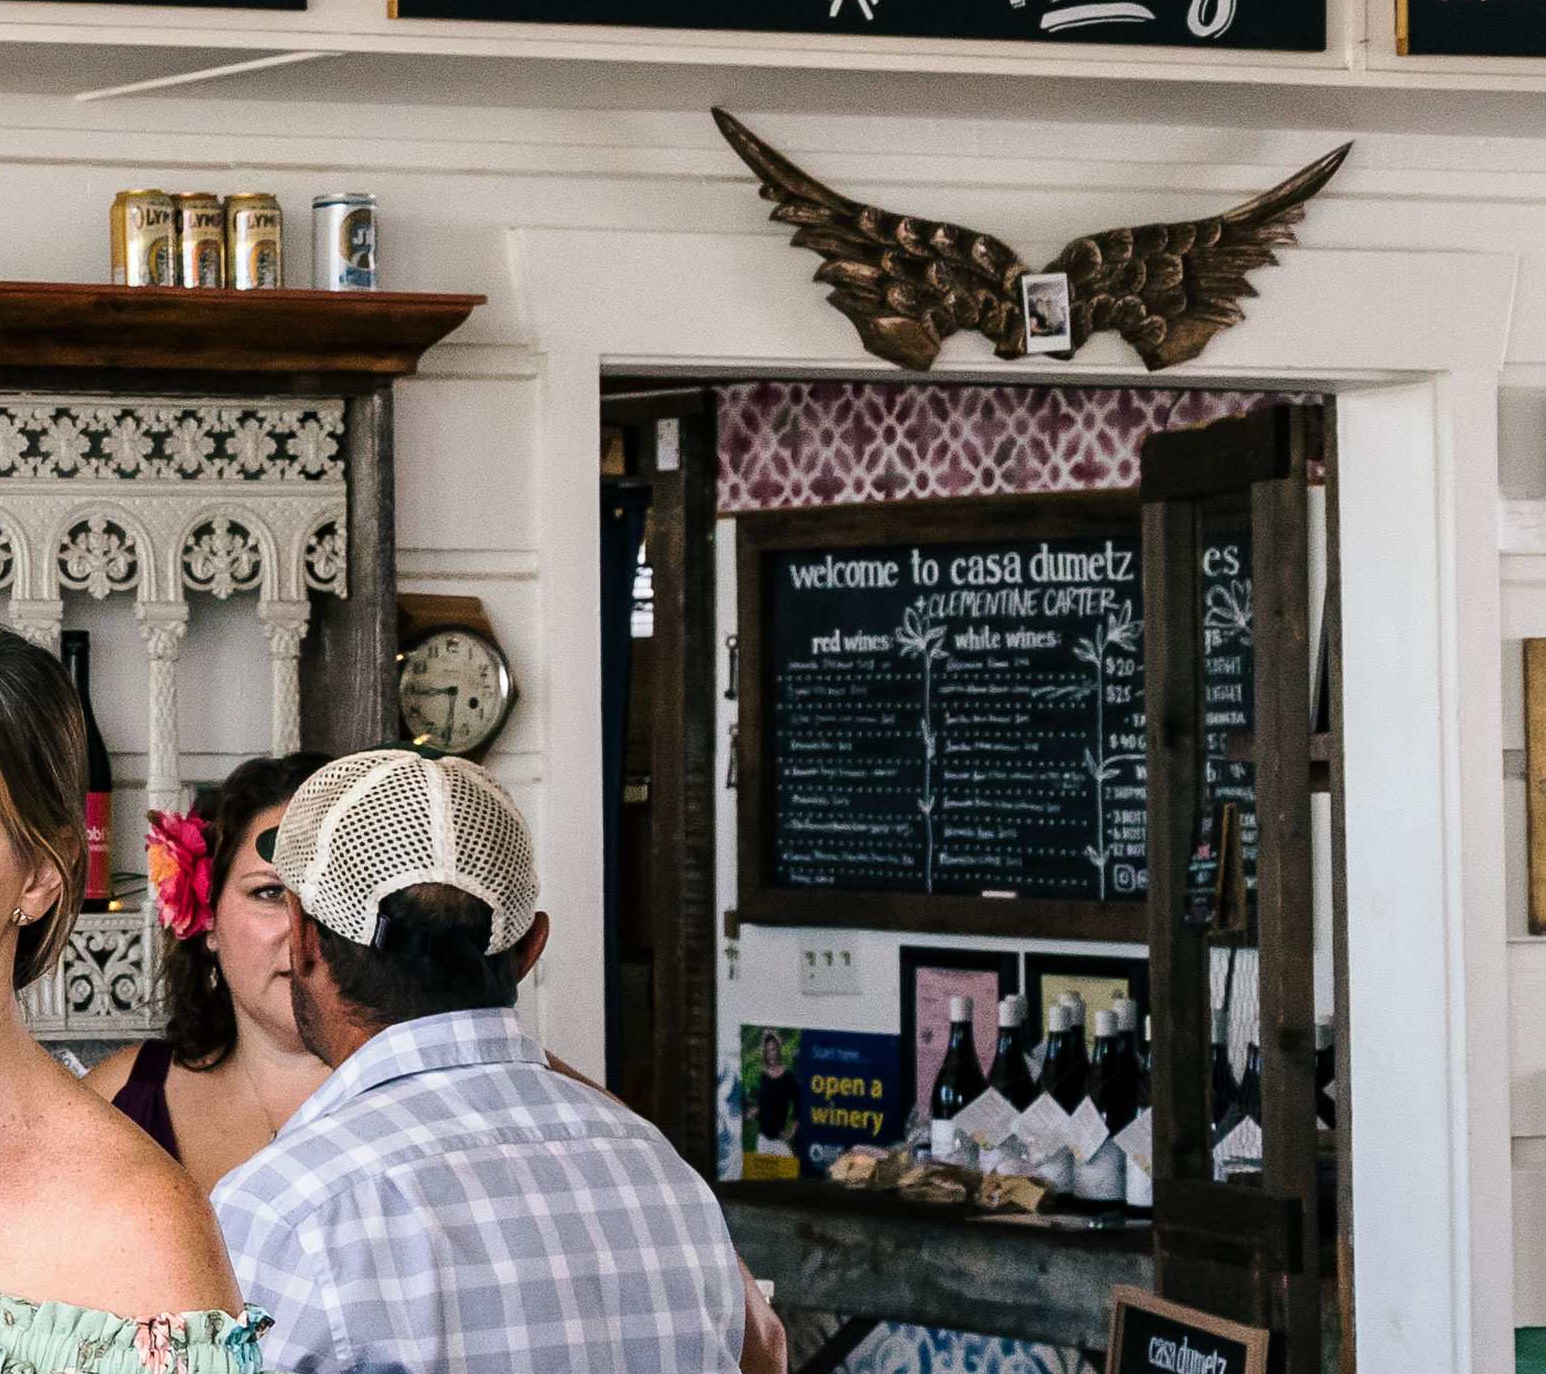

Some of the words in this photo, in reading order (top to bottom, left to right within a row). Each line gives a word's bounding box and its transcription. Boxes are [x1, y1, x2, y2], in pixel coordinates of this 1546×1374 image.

[789, 555, 899, 589] welcome
[912, 549, 939, 585] to
[950, 552, 1023, 585] casa
[1030, 540, 1134, 583] dumetz
[812, 629, 840, 654] red
[954, 625, 1001, 650] white
[811, 1075, 865, 1101] open
[870, 1079, 883, 1098] a
[811, 1106, 883, 1137] winery
[1148, 1336, 1176, 1371] casa
